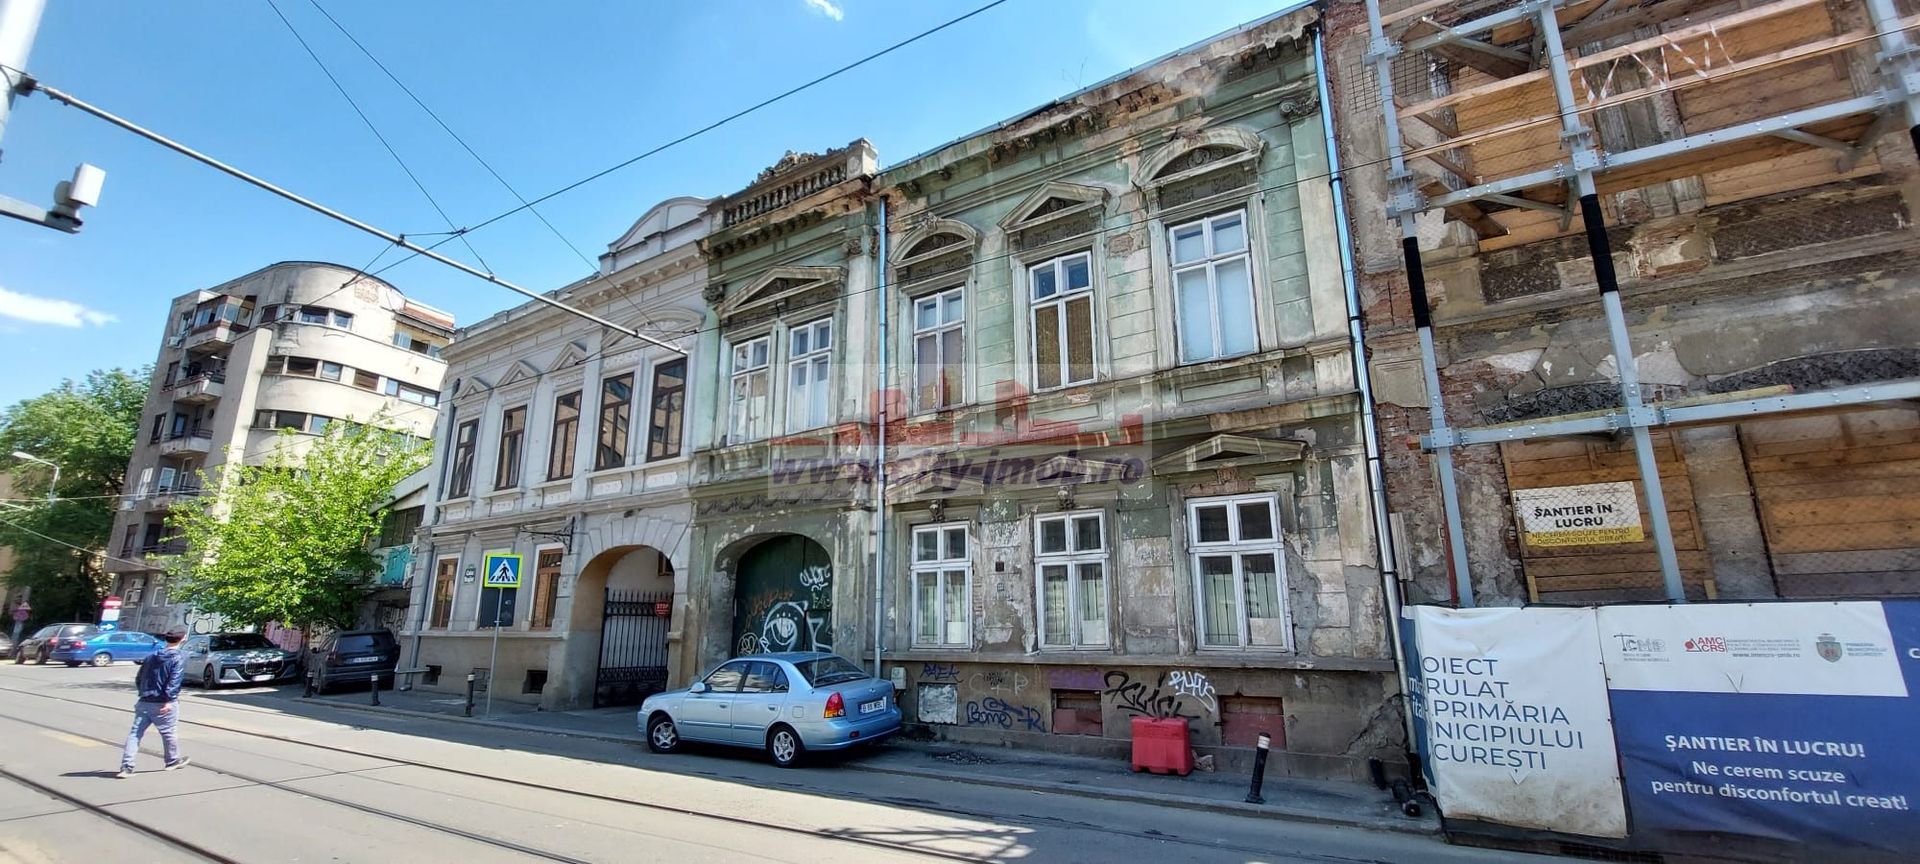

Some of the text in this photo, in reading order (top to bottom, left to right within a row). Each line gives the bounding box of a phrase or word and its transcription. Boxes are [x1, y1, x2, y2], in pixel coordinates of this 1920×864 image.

[1598, 502, 1613, 514] ÎN
[1555, 517, 1604, 528] LUCRU
[1698, 637, 1723, 645] AMC
[1701, 644, 1726, 653] CRS
[1434, 700, 1570, 725] PRIMĂRIA
[1435, 721, 1583, 749] NICIPIULUI
[1665, 734, 1866, 758] ȘANTIER ÎN LUCRU!
[1692, 761, 1846, 783] Ne cerem scuze
[1650, 780, 1909, 810] pentru disconfortul creat!
